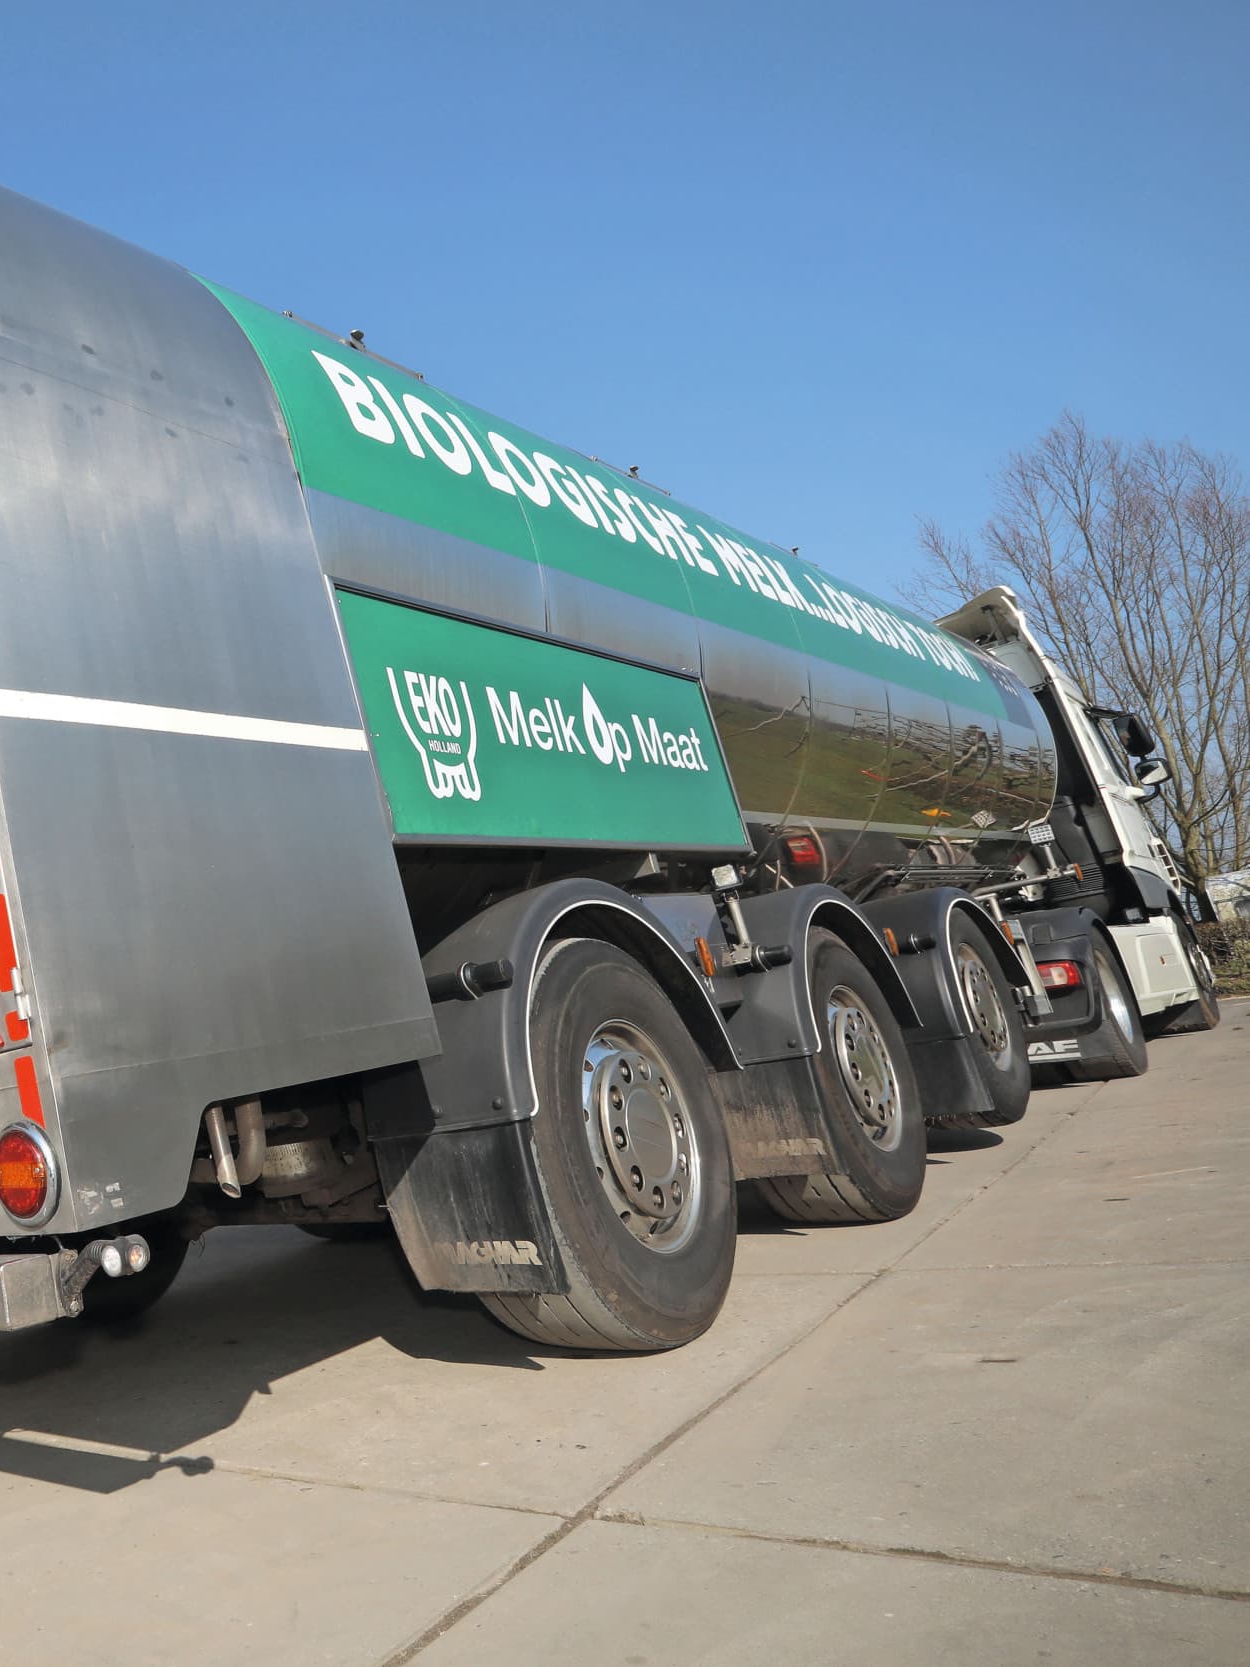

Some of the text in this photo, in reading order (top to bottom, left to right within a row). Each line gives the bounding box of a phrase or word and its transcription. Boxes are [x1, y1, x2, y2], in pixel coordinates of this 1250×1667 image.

[311, 350, 719, 577] BIOLOGISCHE
[403, 670, 462, 738] EKO
[485, 682, 709, 773] Melk Op Maat
[429, 739, 462, 755] HOLLAND
[1027, 1039, 1079, 1055] AF
